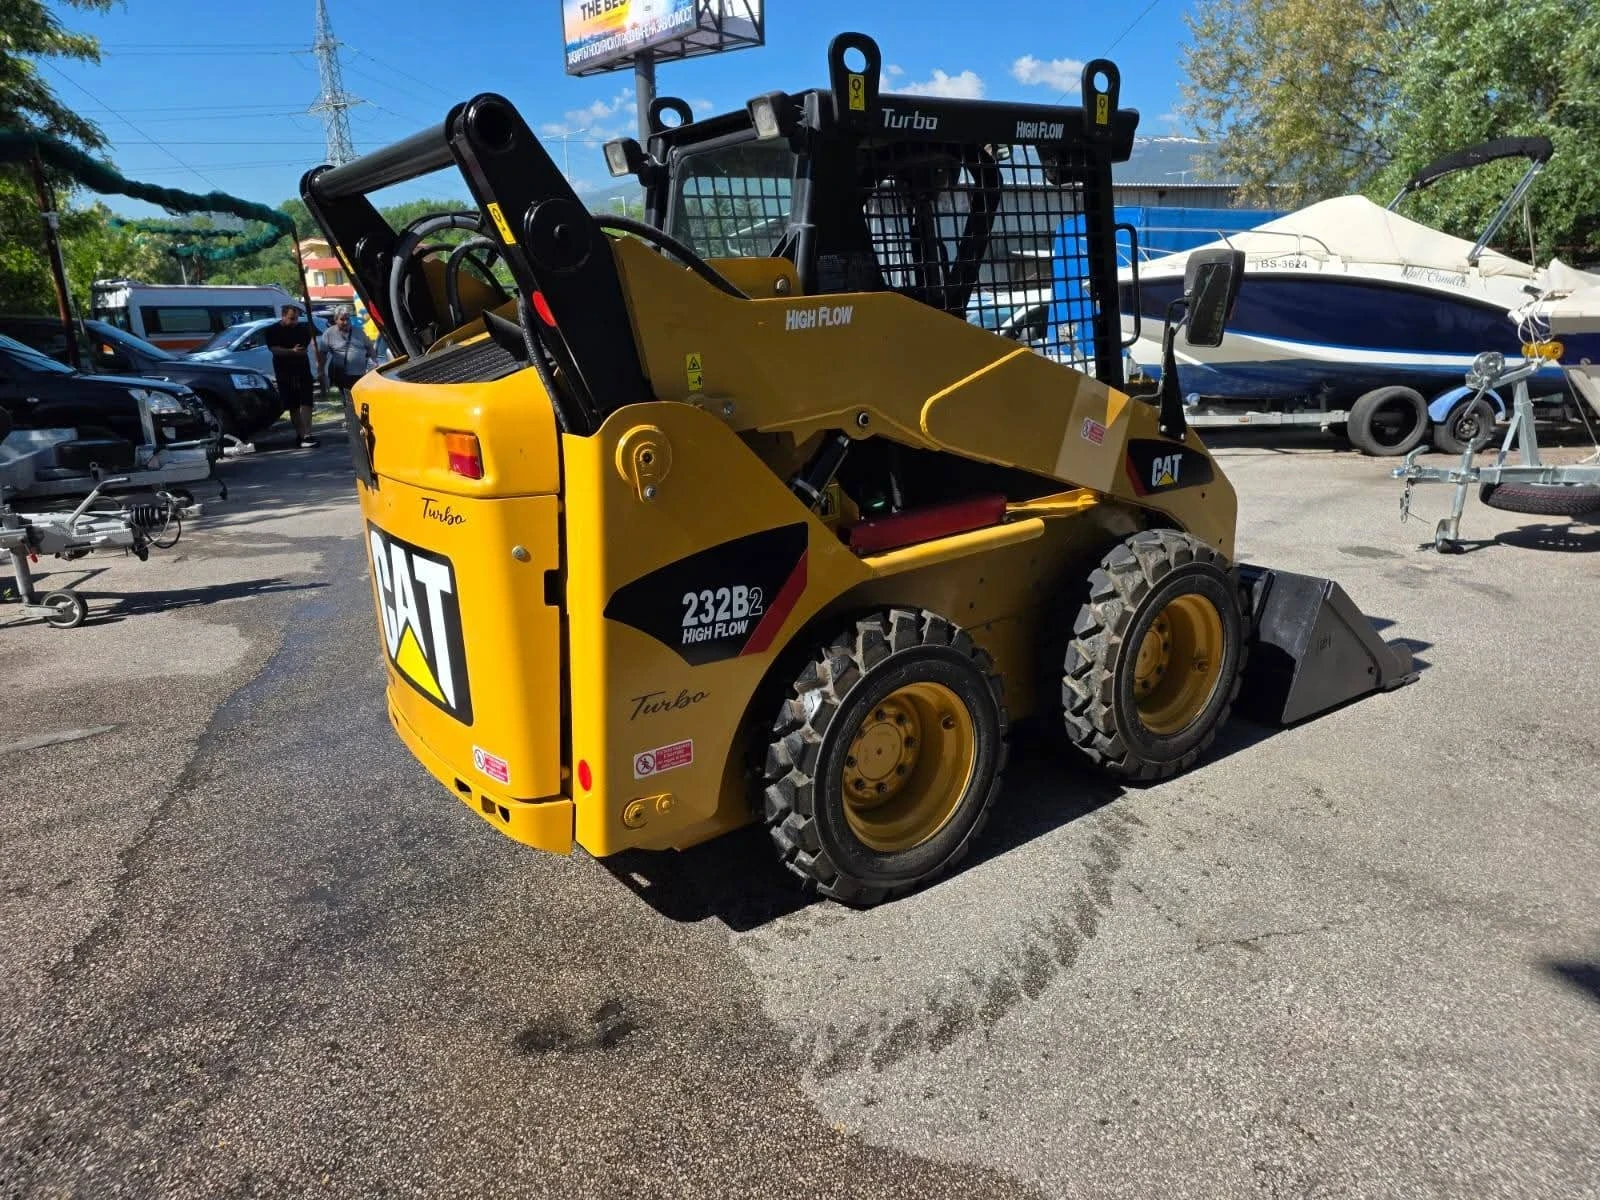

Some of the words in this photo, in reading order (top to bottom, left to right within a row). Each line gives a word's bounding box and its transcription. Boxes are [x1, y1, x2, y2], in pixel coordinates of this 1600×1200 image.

[581, 0, 601, 20] THE
[881, 108, 938, 130] Turbo
[1016, 120, 1038, 139] HIGH
[1038, 121, 1065, 139] FLOW
[785, 309, 817, 331] HIGH
[818, 306, 854, 327] FLOW
[1151, 453, 1183, 487] CAT
[421, 497, 467, 526] Turbo
[370, 530, 457, 709] CAT
[681, 626, 713, 644] HIGH
[713, 620, 749, 639] FLOW
[630, 688, 711, 721] Turbo
